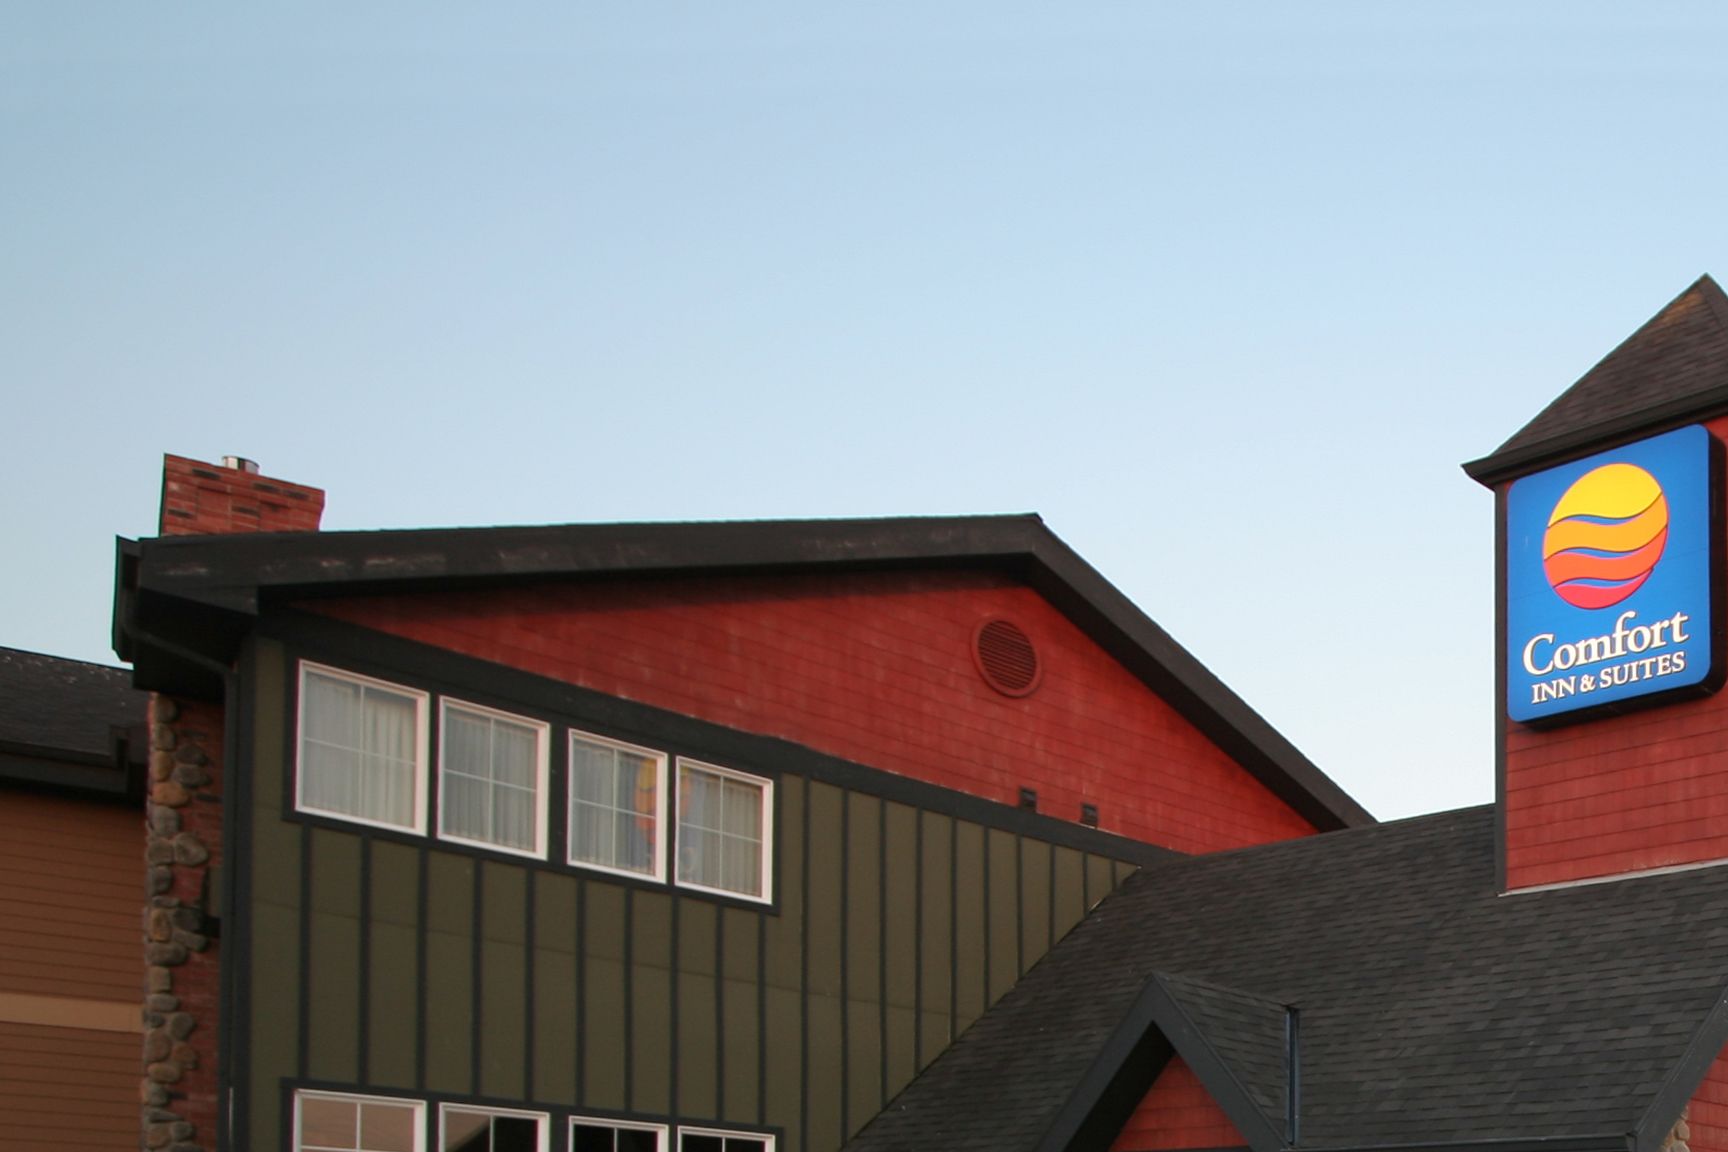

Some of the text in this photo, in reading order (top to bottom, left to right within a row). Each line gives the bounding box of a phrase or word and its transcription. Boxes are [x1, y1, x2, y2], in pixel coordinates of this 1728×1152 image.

[1522, 610, 1689, 677] Comfort
[1531, 651, 1687, 704] INN & SUITES
